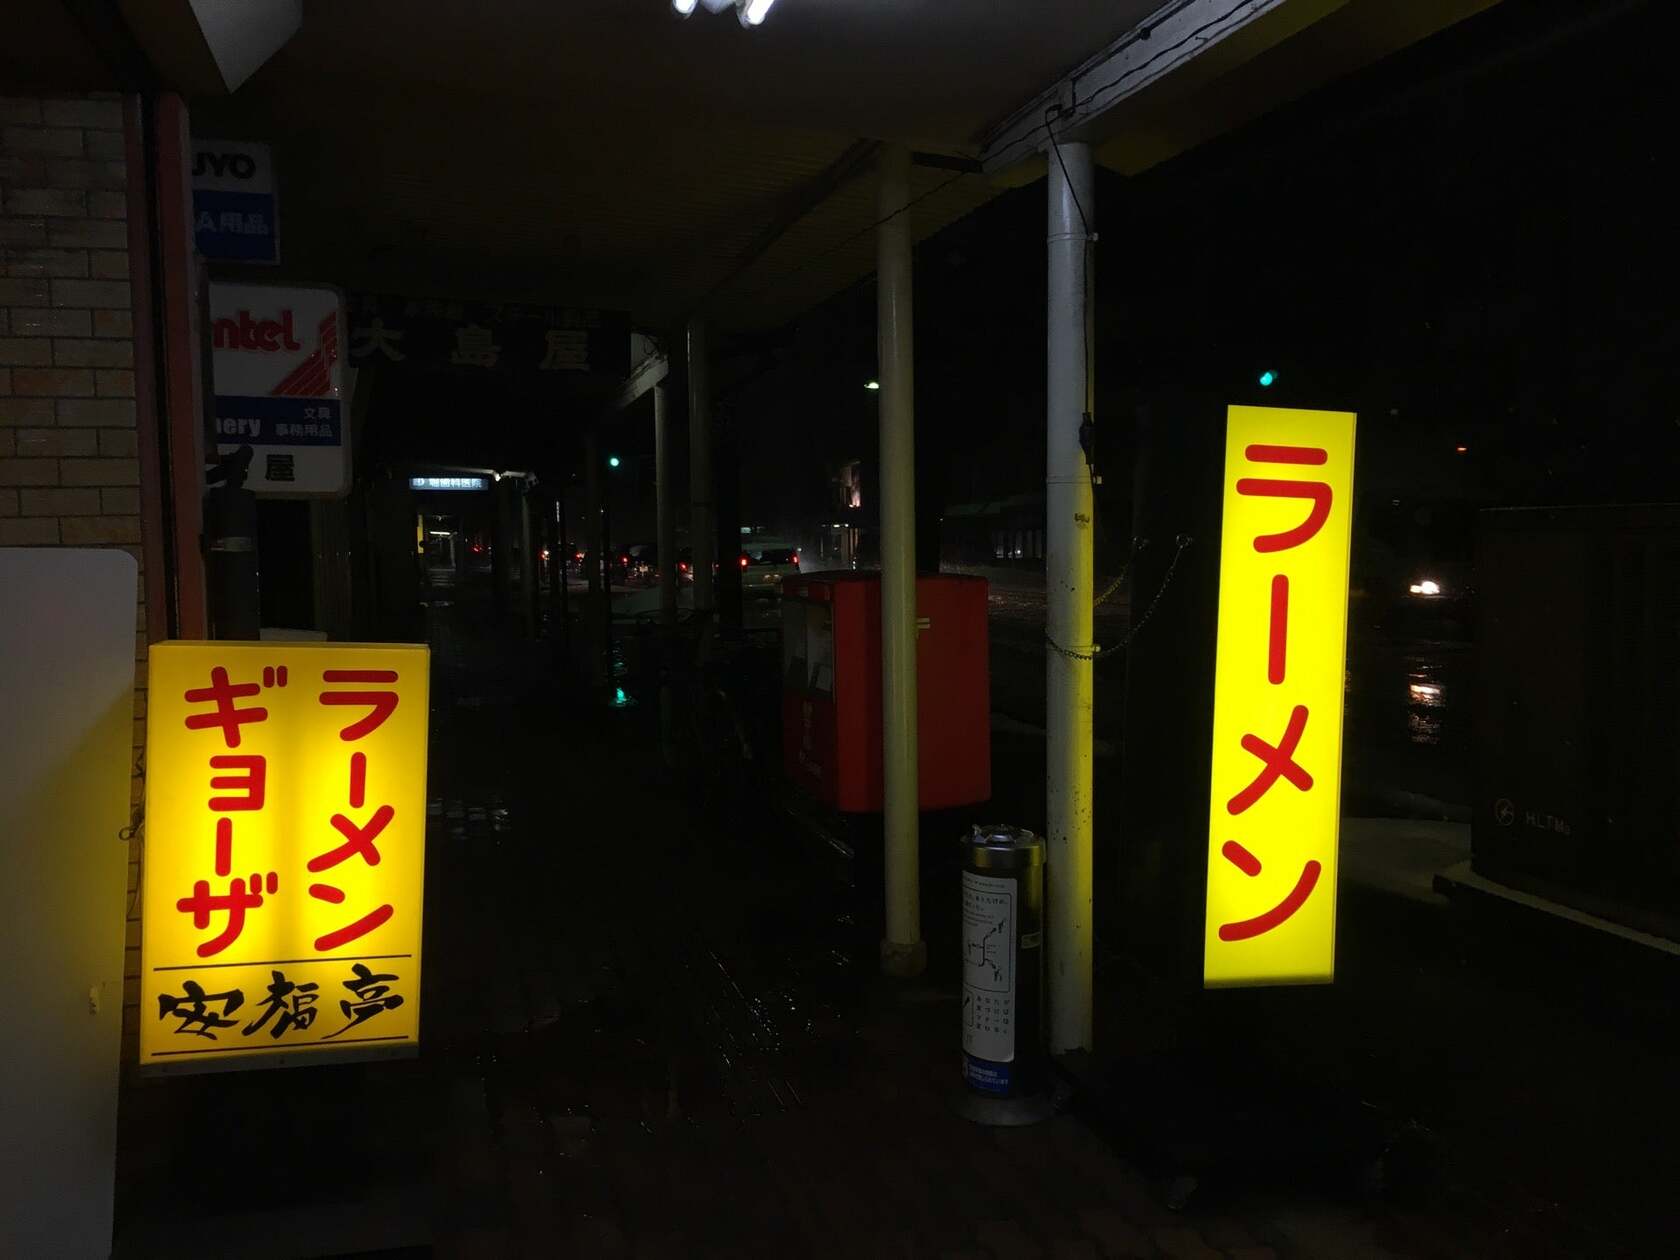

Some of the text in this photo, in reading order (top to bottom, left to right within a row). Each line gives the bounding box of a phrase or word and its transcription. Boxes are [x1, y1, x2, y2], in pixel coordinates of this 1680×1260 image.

[350, 317, 590, 372] 大島屋
[176, 665, 288, 958] ギョーザ
[306, 670, 399, 952] ラーメン
[1218, 444, 1334, 942] ラーメン
[157, 963, 404, 1041] 安福亭
